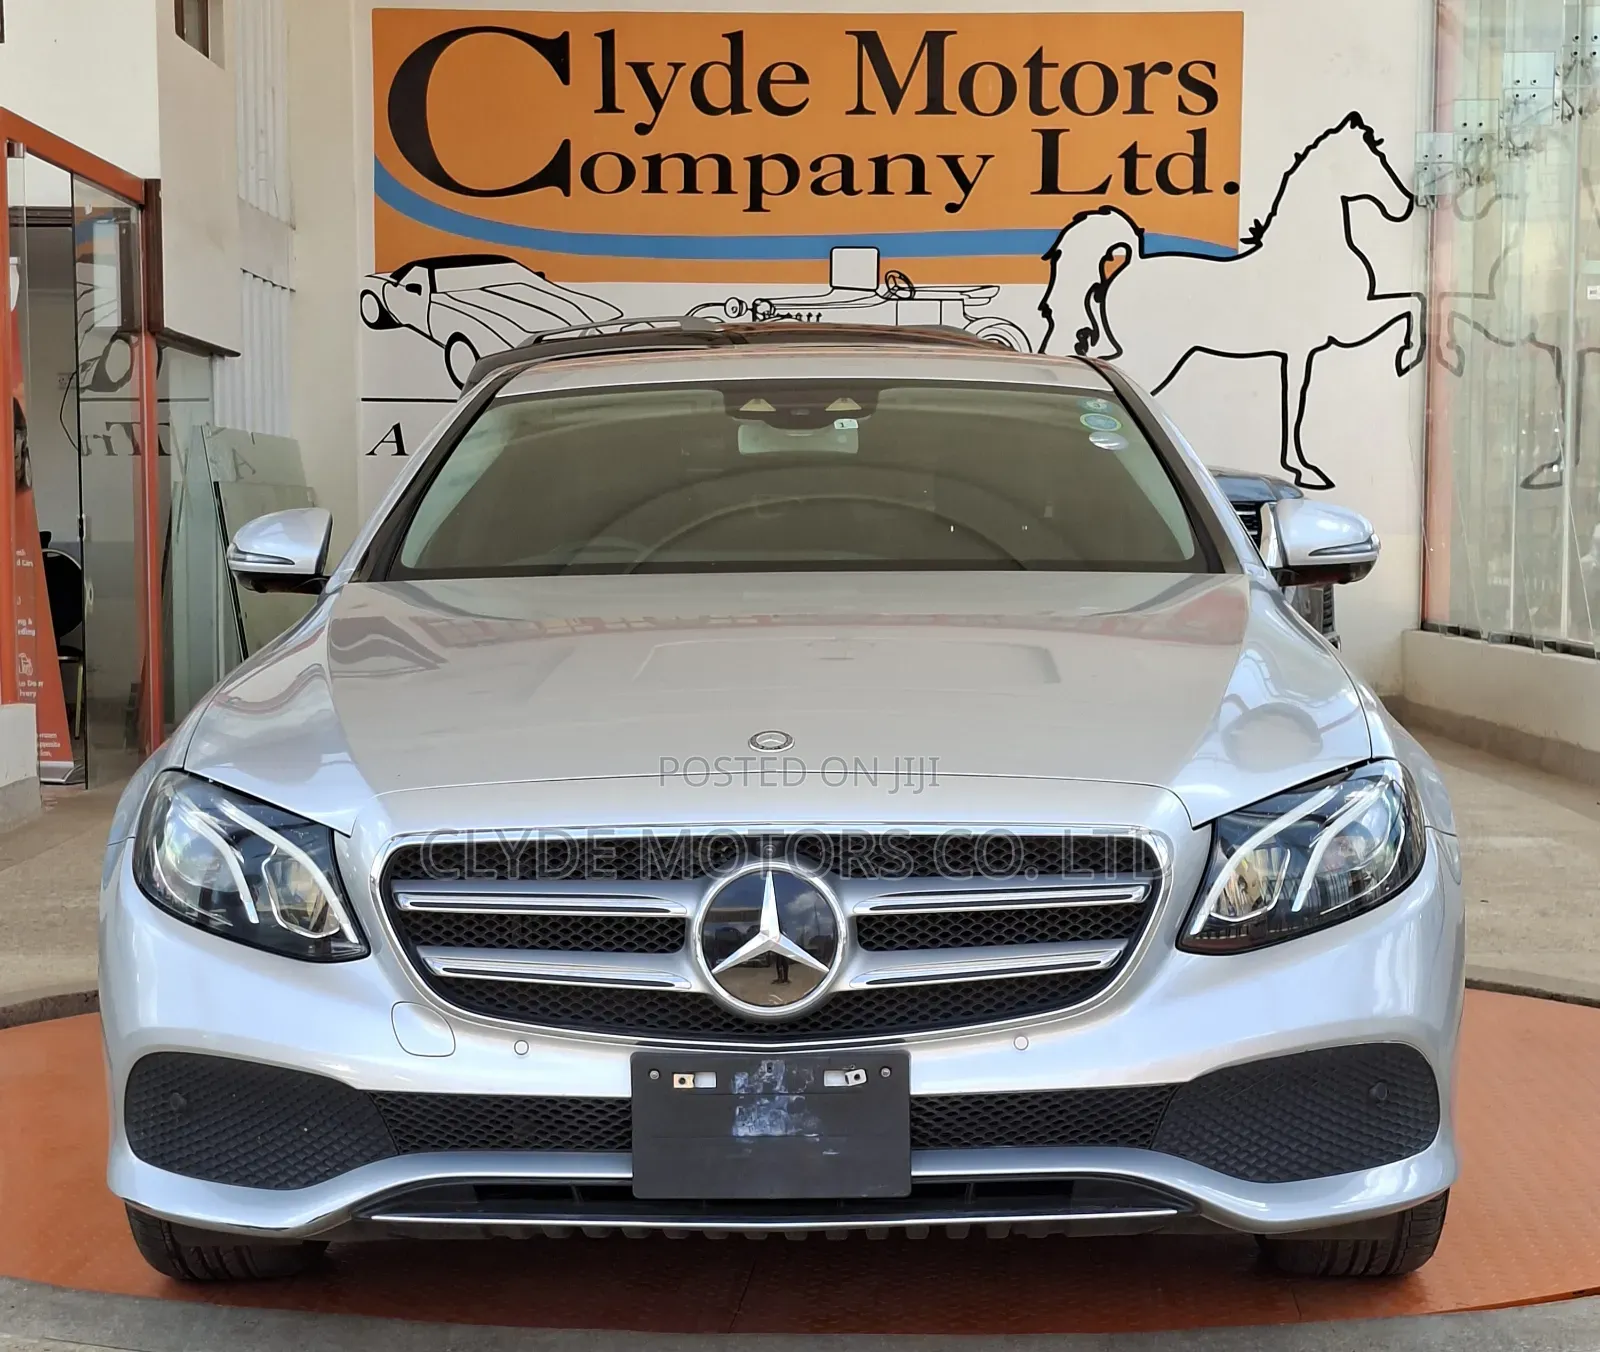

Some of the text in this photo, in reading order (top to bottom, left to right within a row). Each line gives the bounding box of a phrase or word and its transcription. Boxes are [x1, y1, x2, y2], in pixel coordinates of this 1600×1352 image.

[387, 25, 1219, 198] Clyde Motors
[1030, 127, 1240, 197] Ltd.
